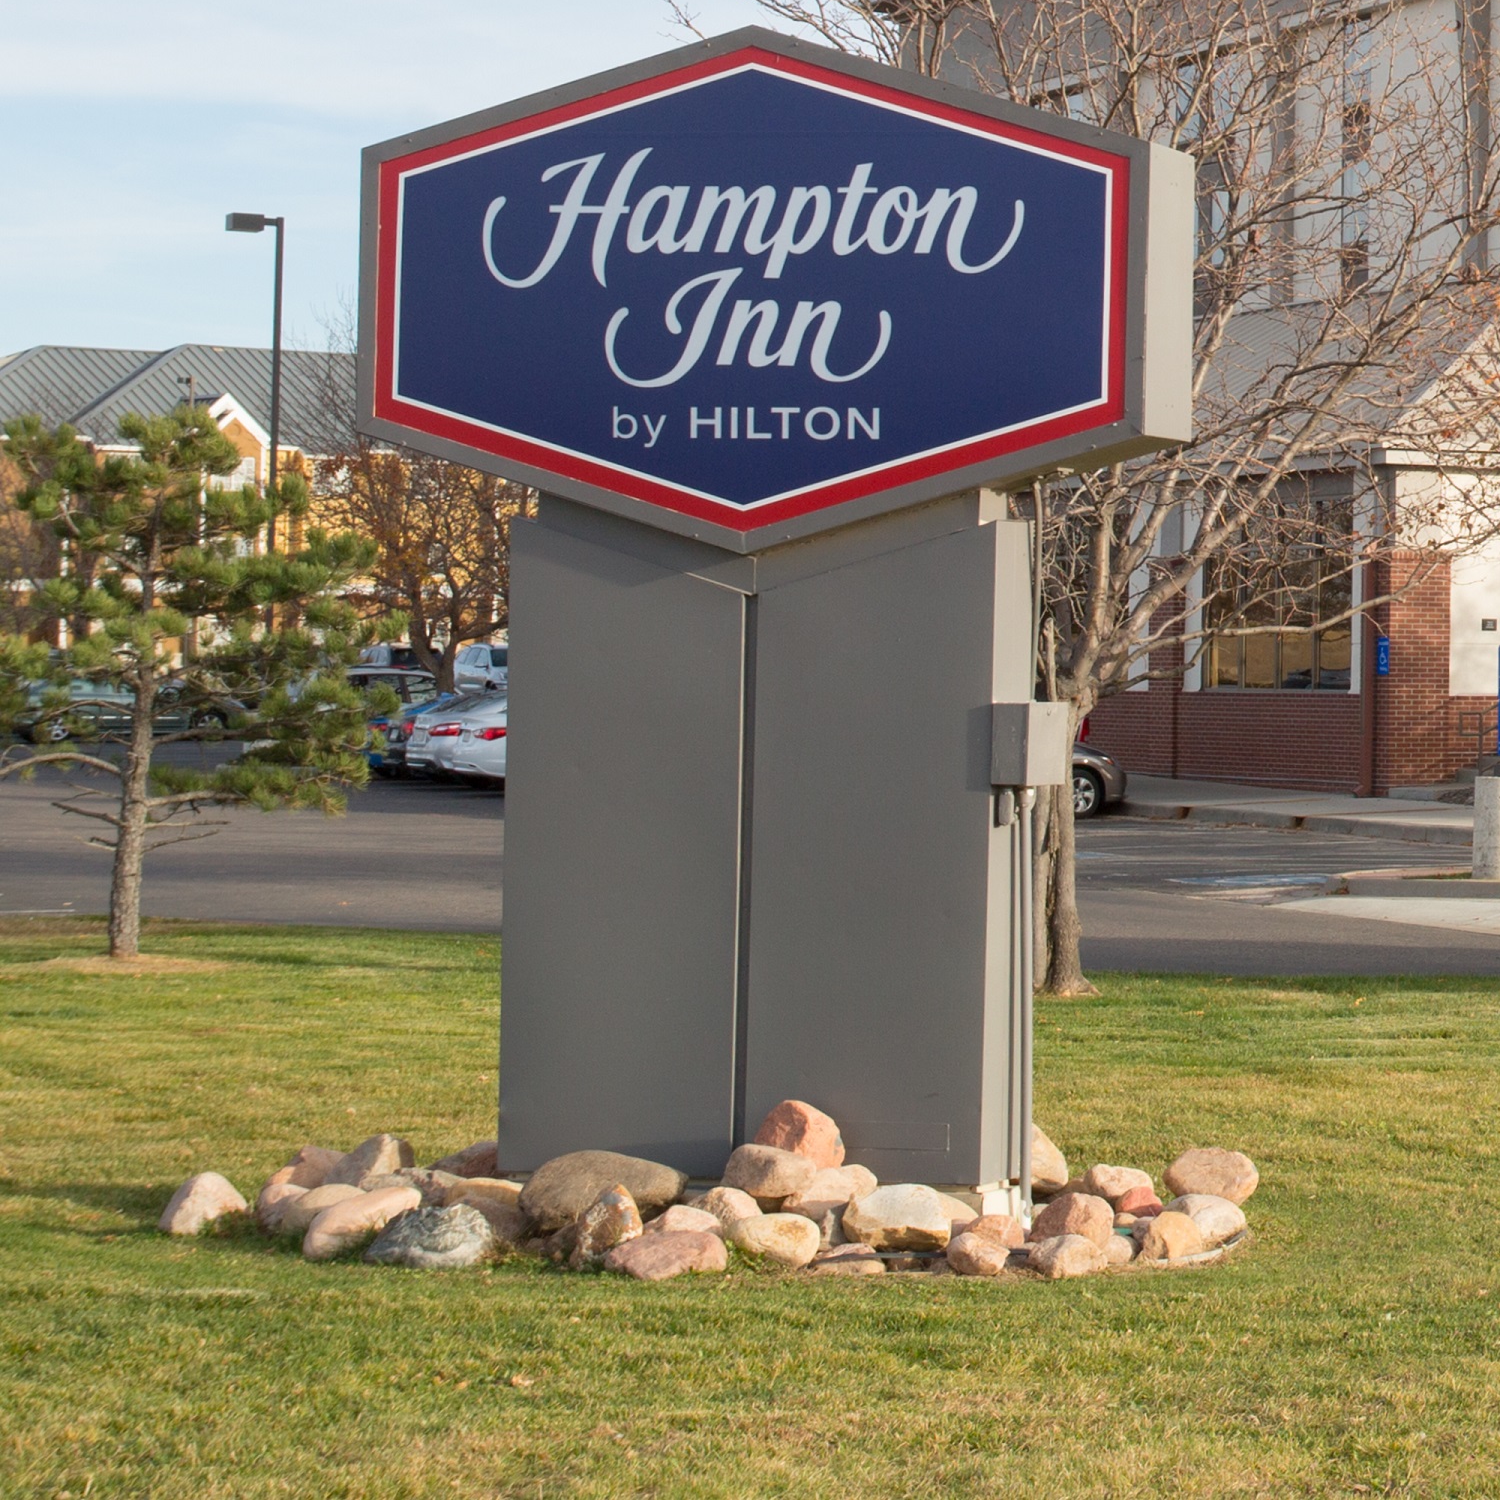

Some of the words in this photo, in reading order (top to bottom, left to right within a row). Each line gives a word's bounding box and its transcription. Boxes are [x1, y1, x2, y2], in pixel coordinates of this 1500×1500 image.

[482, 146, 1025, 289] Hampton
[604, 267, 892, 388] Inn
[612, 406, 667, 448] by
[690, 406, 881, 440] HILTON
